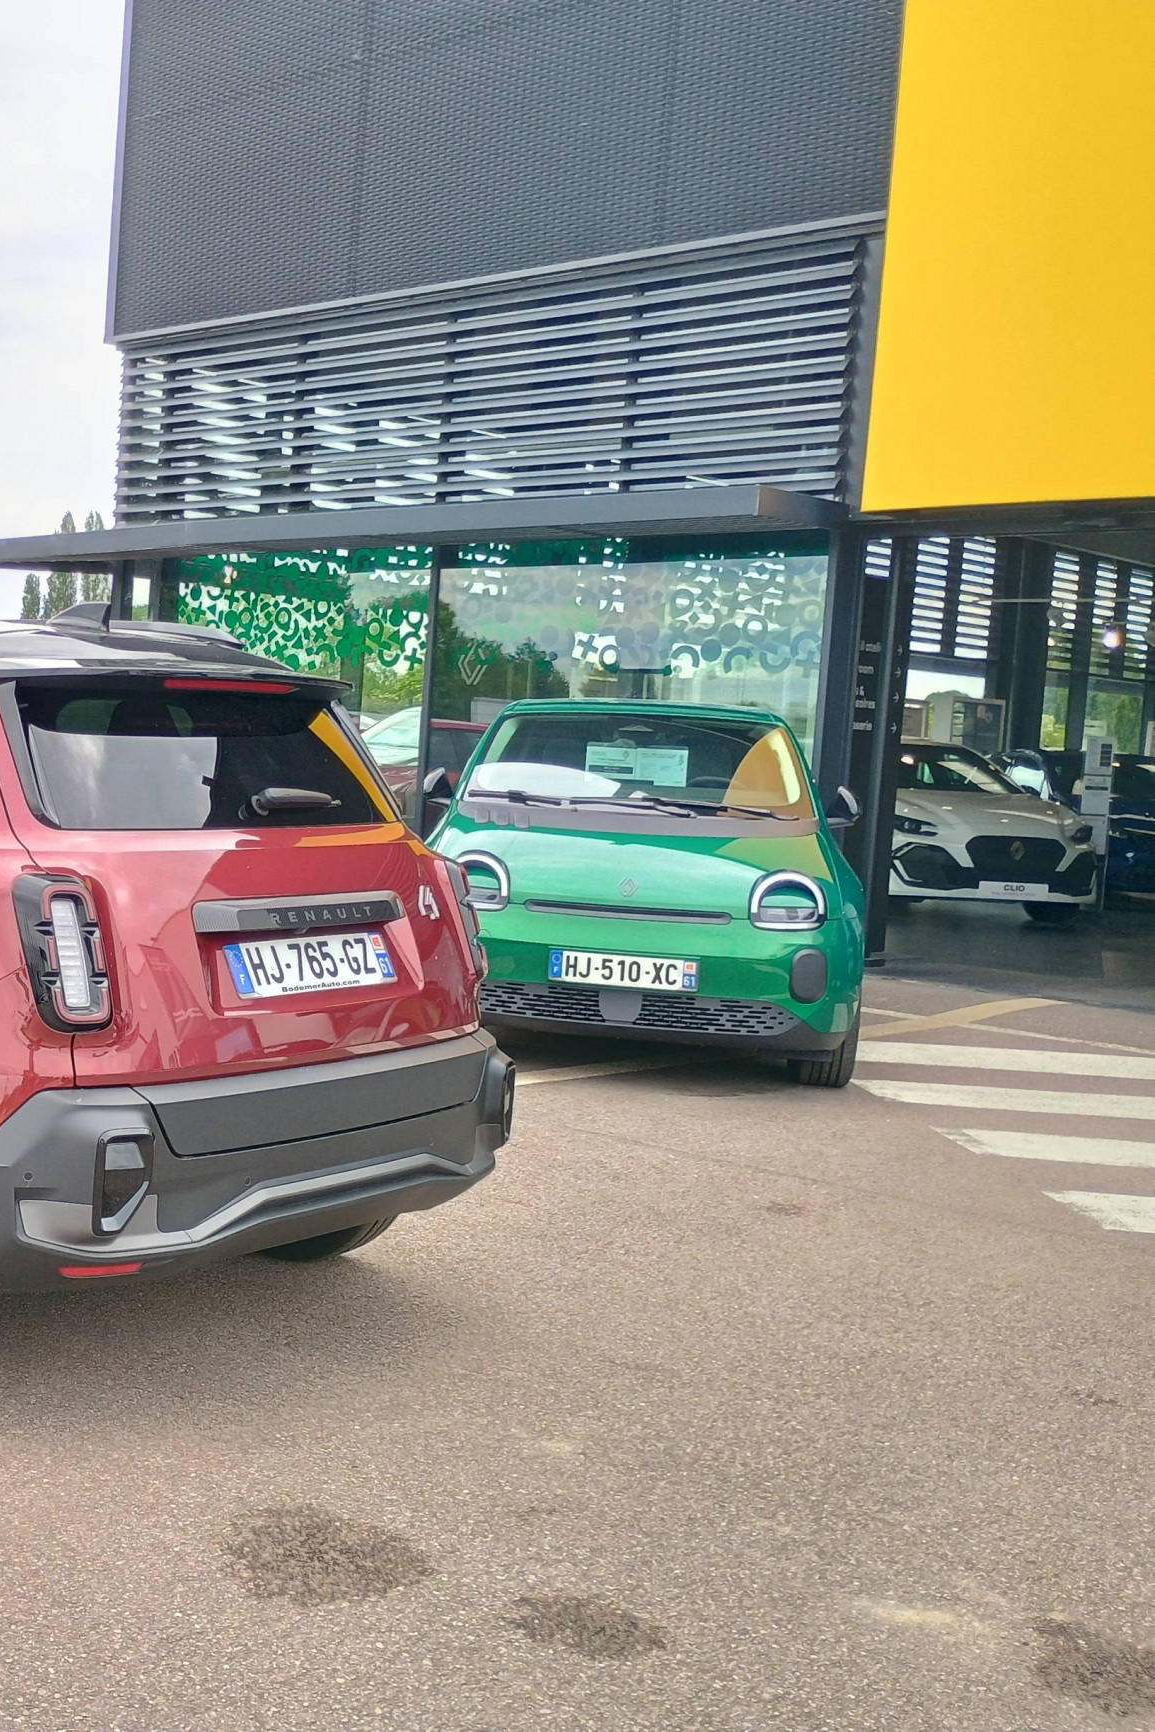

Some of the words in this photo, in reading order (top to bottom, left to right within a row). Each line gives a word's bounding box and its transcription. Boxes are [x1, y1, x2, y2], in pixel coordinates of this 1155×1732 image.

[1003, 884, 1025, 892] CLIO
[270, 906, 372, 924] RENAULT
[245, 937, 377, 986] HJ-765-GZ
[379, 956, 394, 974] 61
[564, 954, 678, 985] HJ-510-XC
[683, 976, 696, 987] 61
[281, 978, 361, 993] BodemerAuto.com
